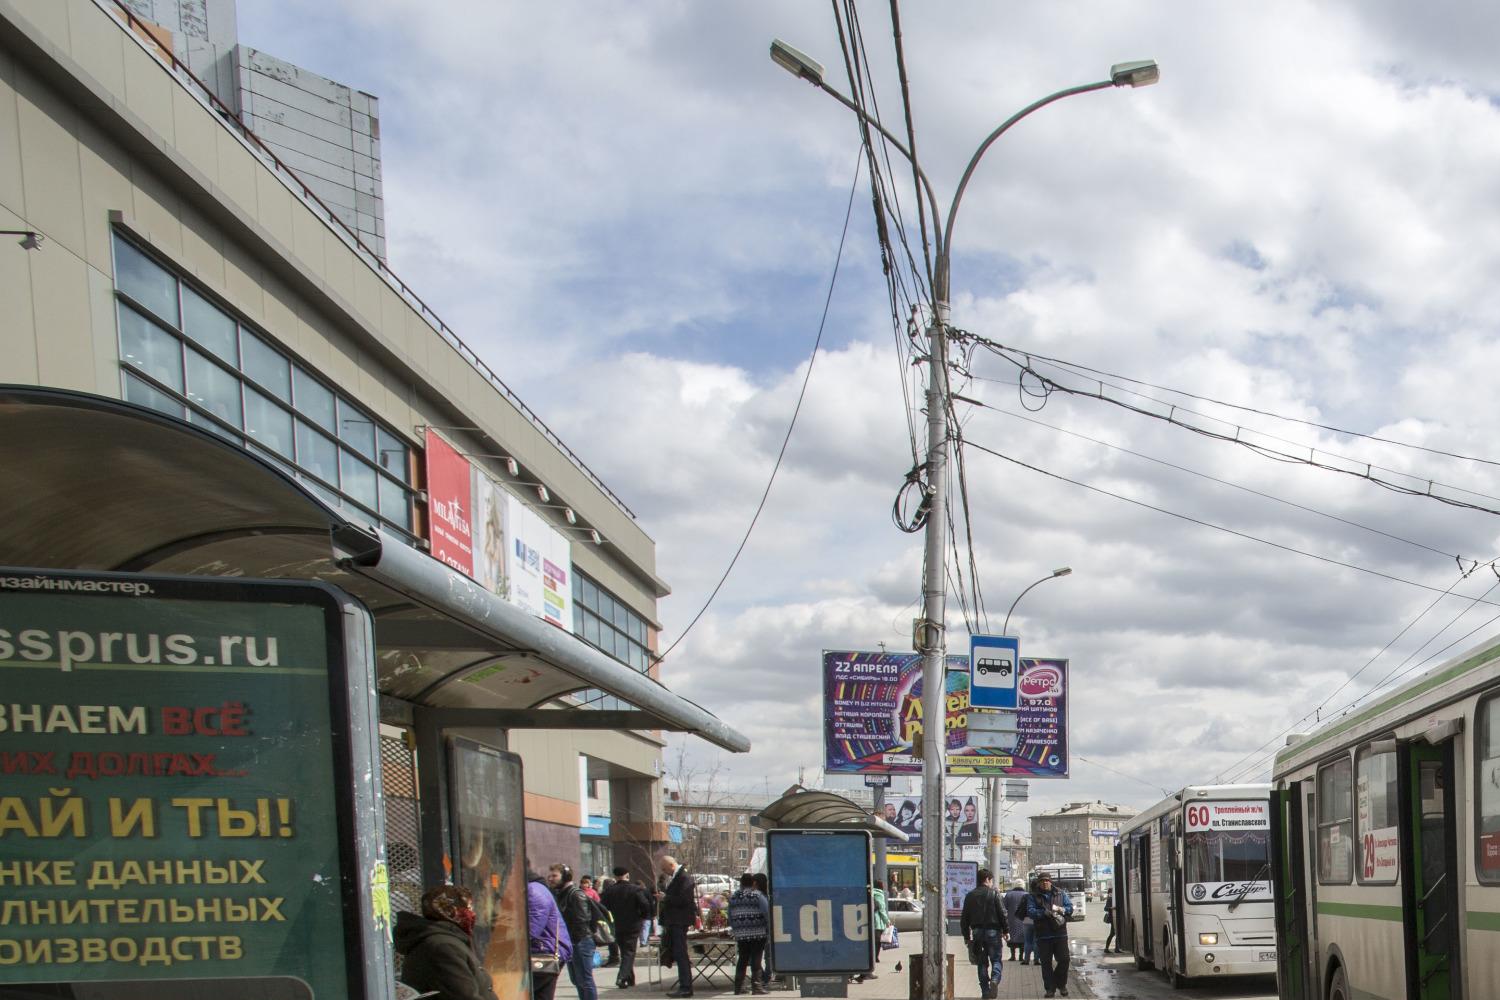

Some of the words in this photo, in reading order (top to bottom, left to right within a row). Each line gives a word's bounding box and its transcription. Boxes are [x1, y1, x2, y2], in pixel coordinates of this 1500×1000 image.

[0, 576, 155, 595] зайнмастер.
[835, 662, 850, 672] 22
[853, 664, 898, 673] АПРЕЛЯ
[162, 701, 251, 736] ВСЁ
[109, 797, 154, 837] И
[172, 797, 292, 838] ТЫ!
[1188, 805, 1210, 827] 60
[1364, 833, 1376, 878] 29
[0, 861, 77, 886] НКЕ
[87, 859, 266, 890] ДАННЫХ
[1, 898, 287, 925] ЛНИТЕЛЬНЫХ
[0, 936, 243, 966] ОИЗВОДСТВ
